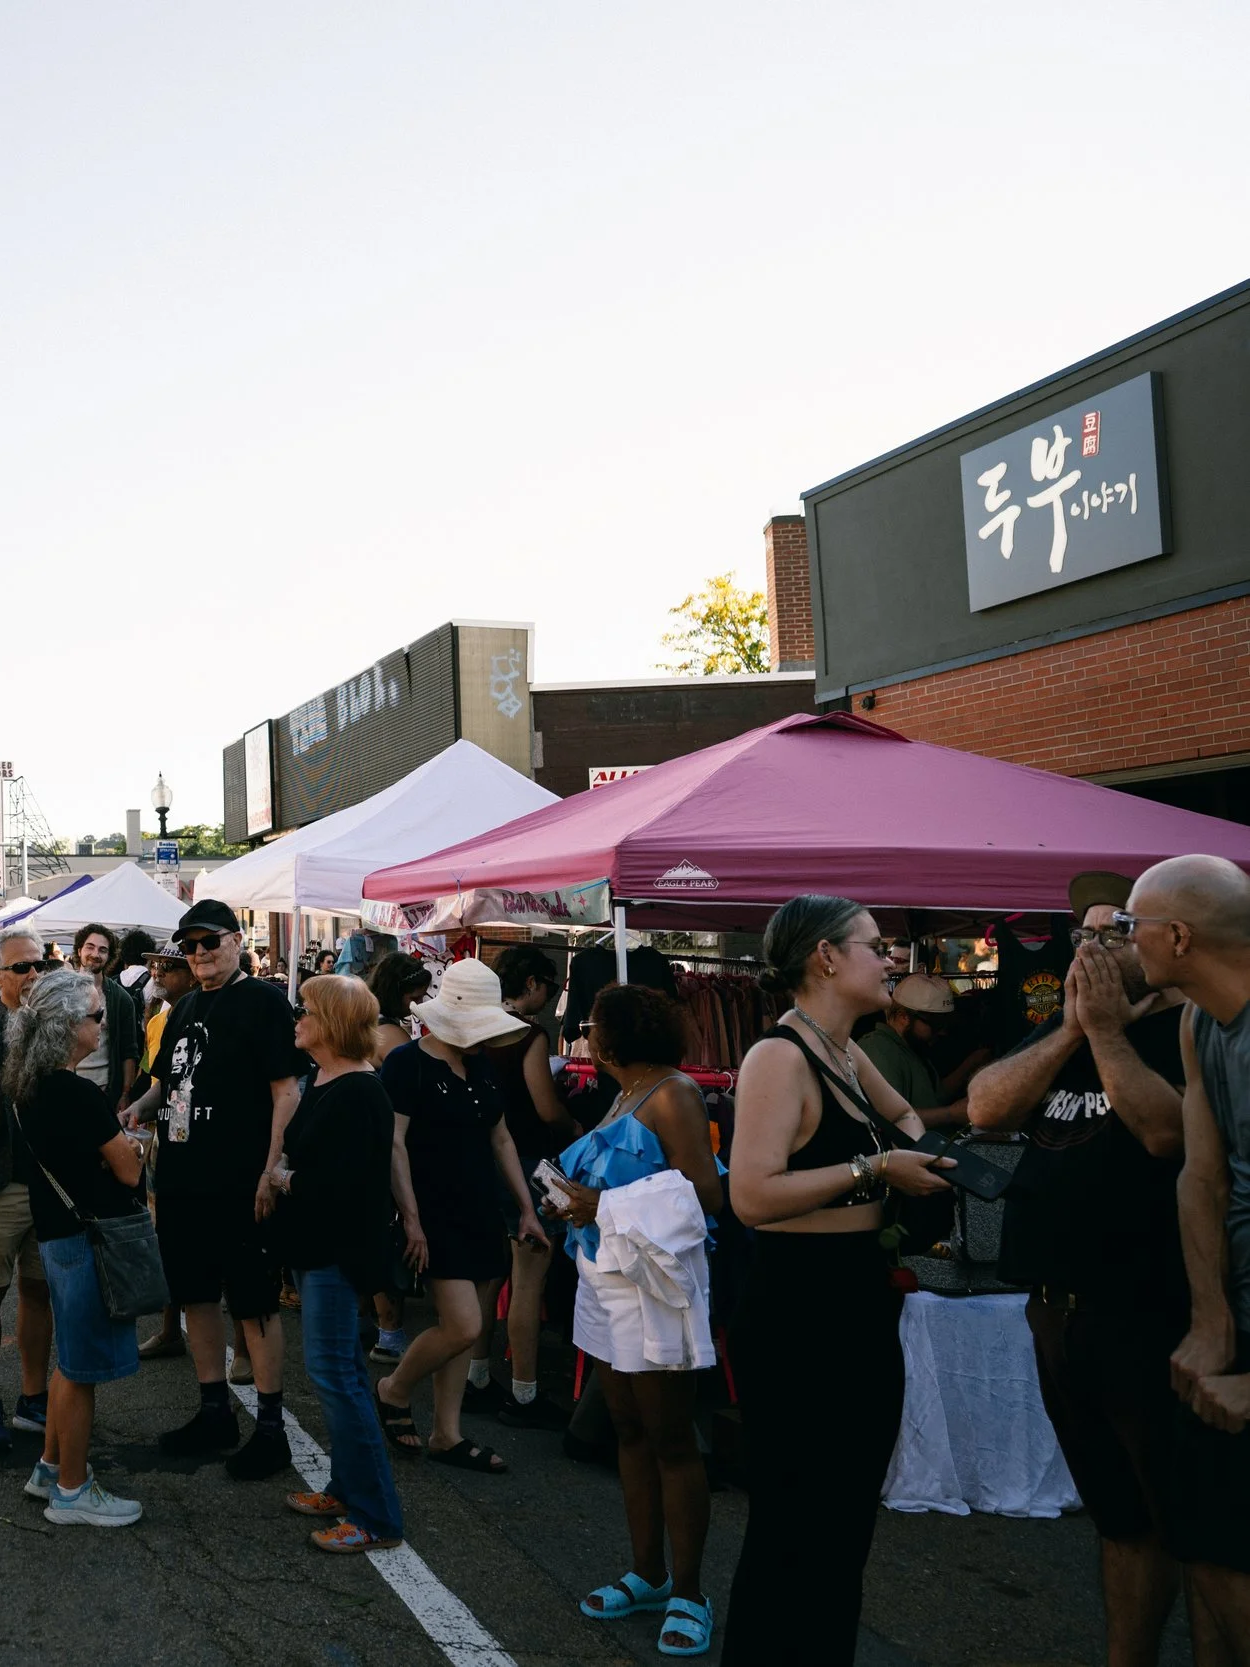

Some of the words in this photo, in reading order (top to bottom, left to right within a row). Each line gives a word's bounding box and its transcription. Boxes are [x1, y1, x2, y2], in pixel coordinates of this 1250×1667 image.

[1082, 411, 1098, 456] 豆腐
[976, 424, 1082, 573] 두부
[1070, 473, 1137, 520] 이야기
